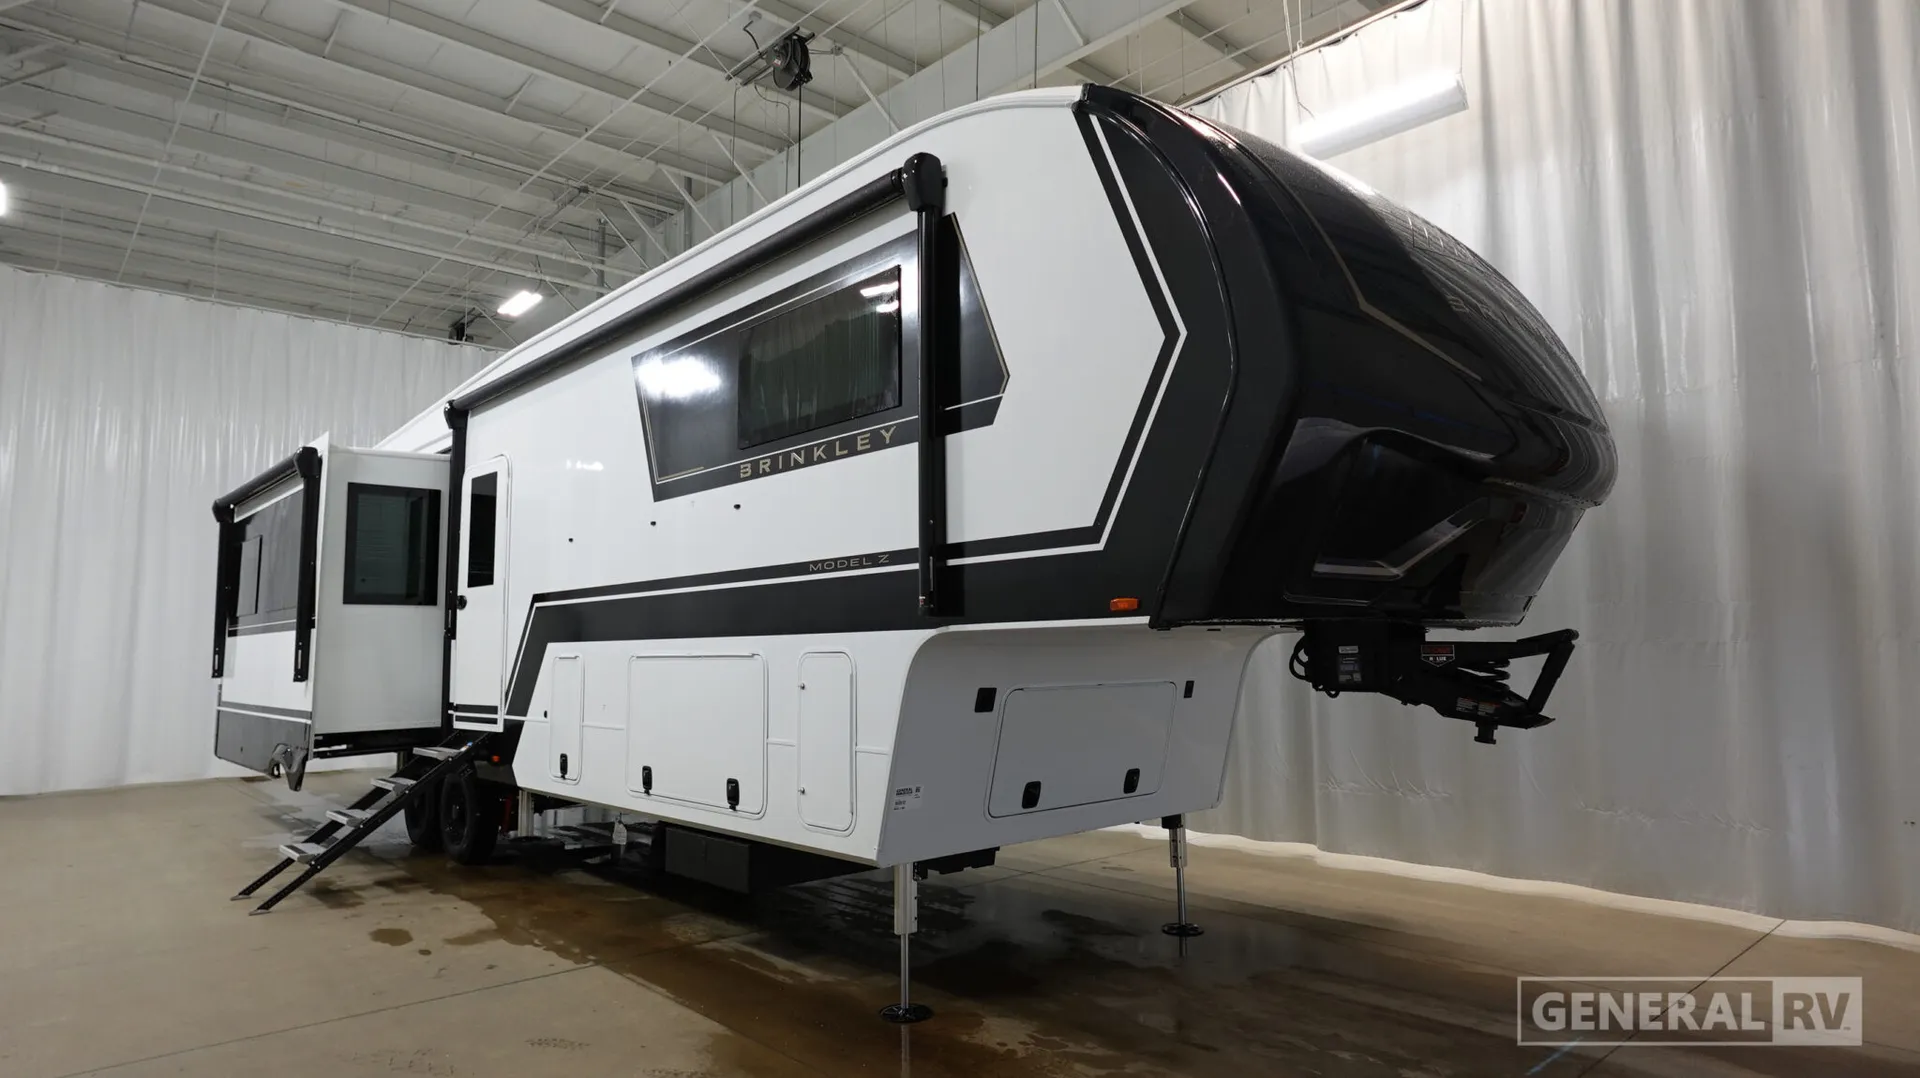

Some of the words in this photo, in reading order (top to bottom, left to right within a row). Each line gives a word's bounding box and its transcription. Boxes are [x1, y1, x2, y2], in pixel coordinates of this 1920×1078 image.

[740, 426, 897, 479] BRINKLEY
[809, 557, 872, 572] MODEL
[878, 554, 890, 564] Z
